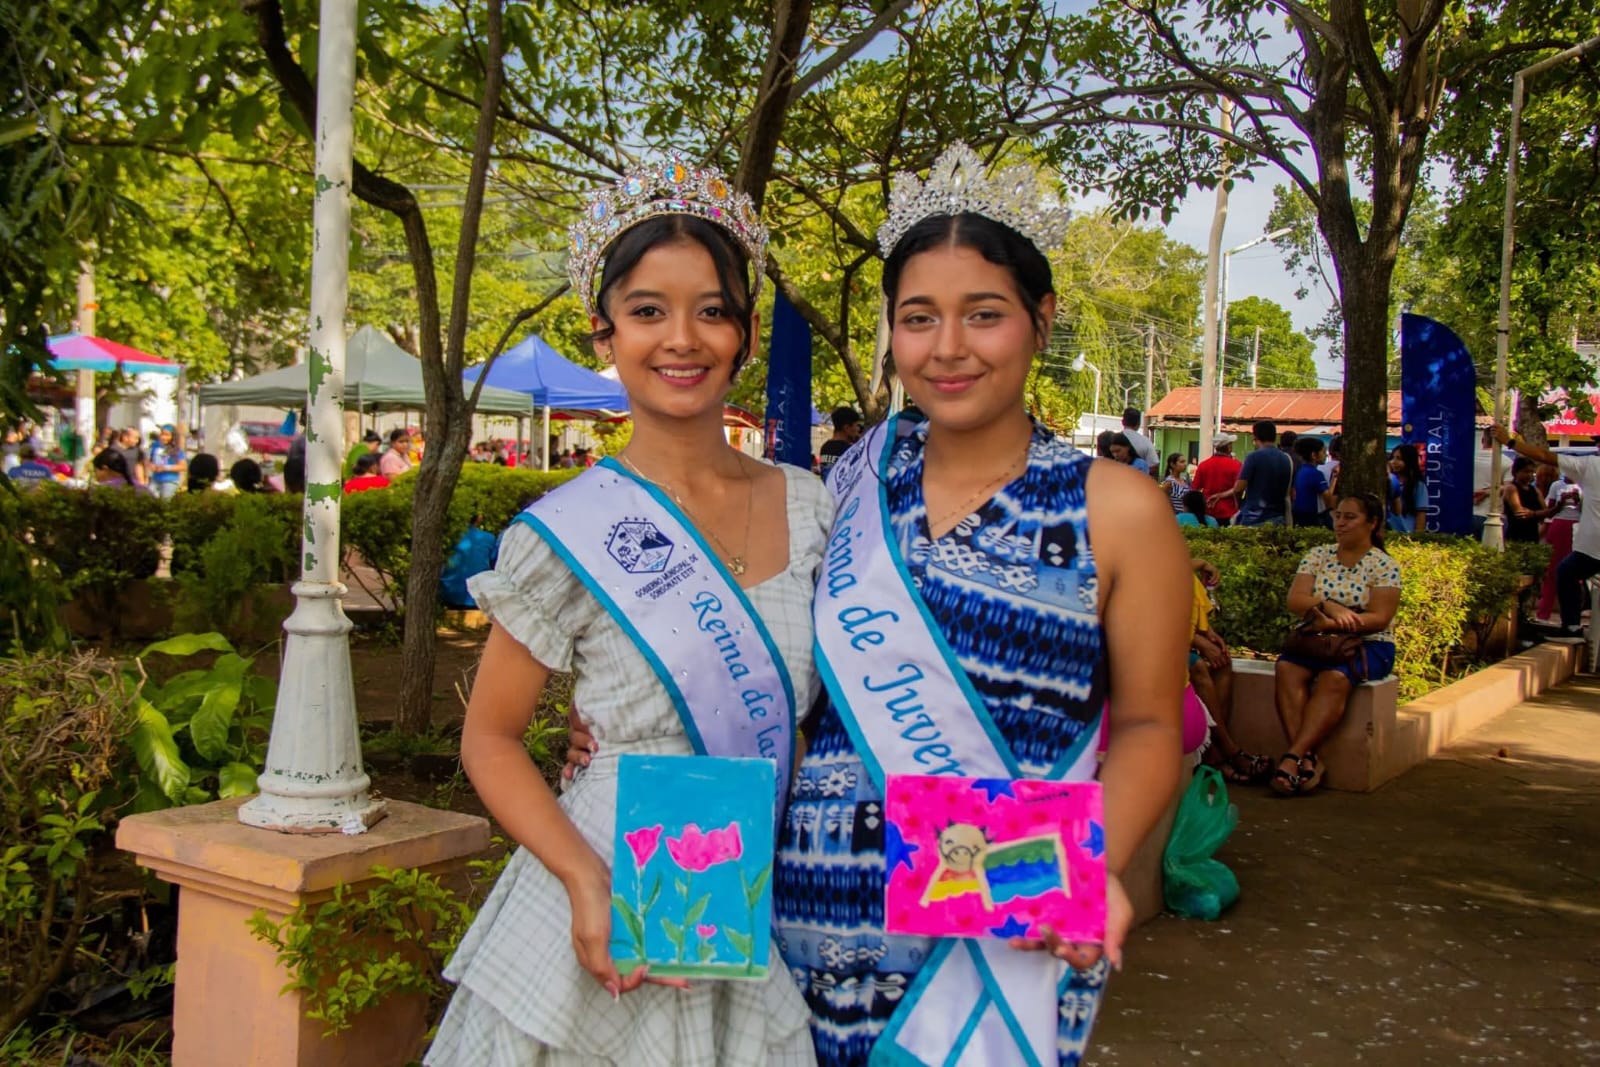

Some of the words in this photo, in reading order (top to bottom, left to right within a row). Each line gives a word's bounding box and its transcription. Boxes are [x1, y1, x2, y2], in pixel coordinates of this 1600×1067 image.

[1425, 411, 1443, 533] CULTURAL
[635, 577, 663, 598] GOBIERNO
[661, 560, 691, 581] MUNICIPAL
[688, 553, 698, 563] DE
[650, 575, 682, 600] SONSONATE
[680, 566, 696, 579] ESTE
[837, 605, 899, 652] de
[690, 591, 750, 682] Reina
[742, 688, 773, 721] de
